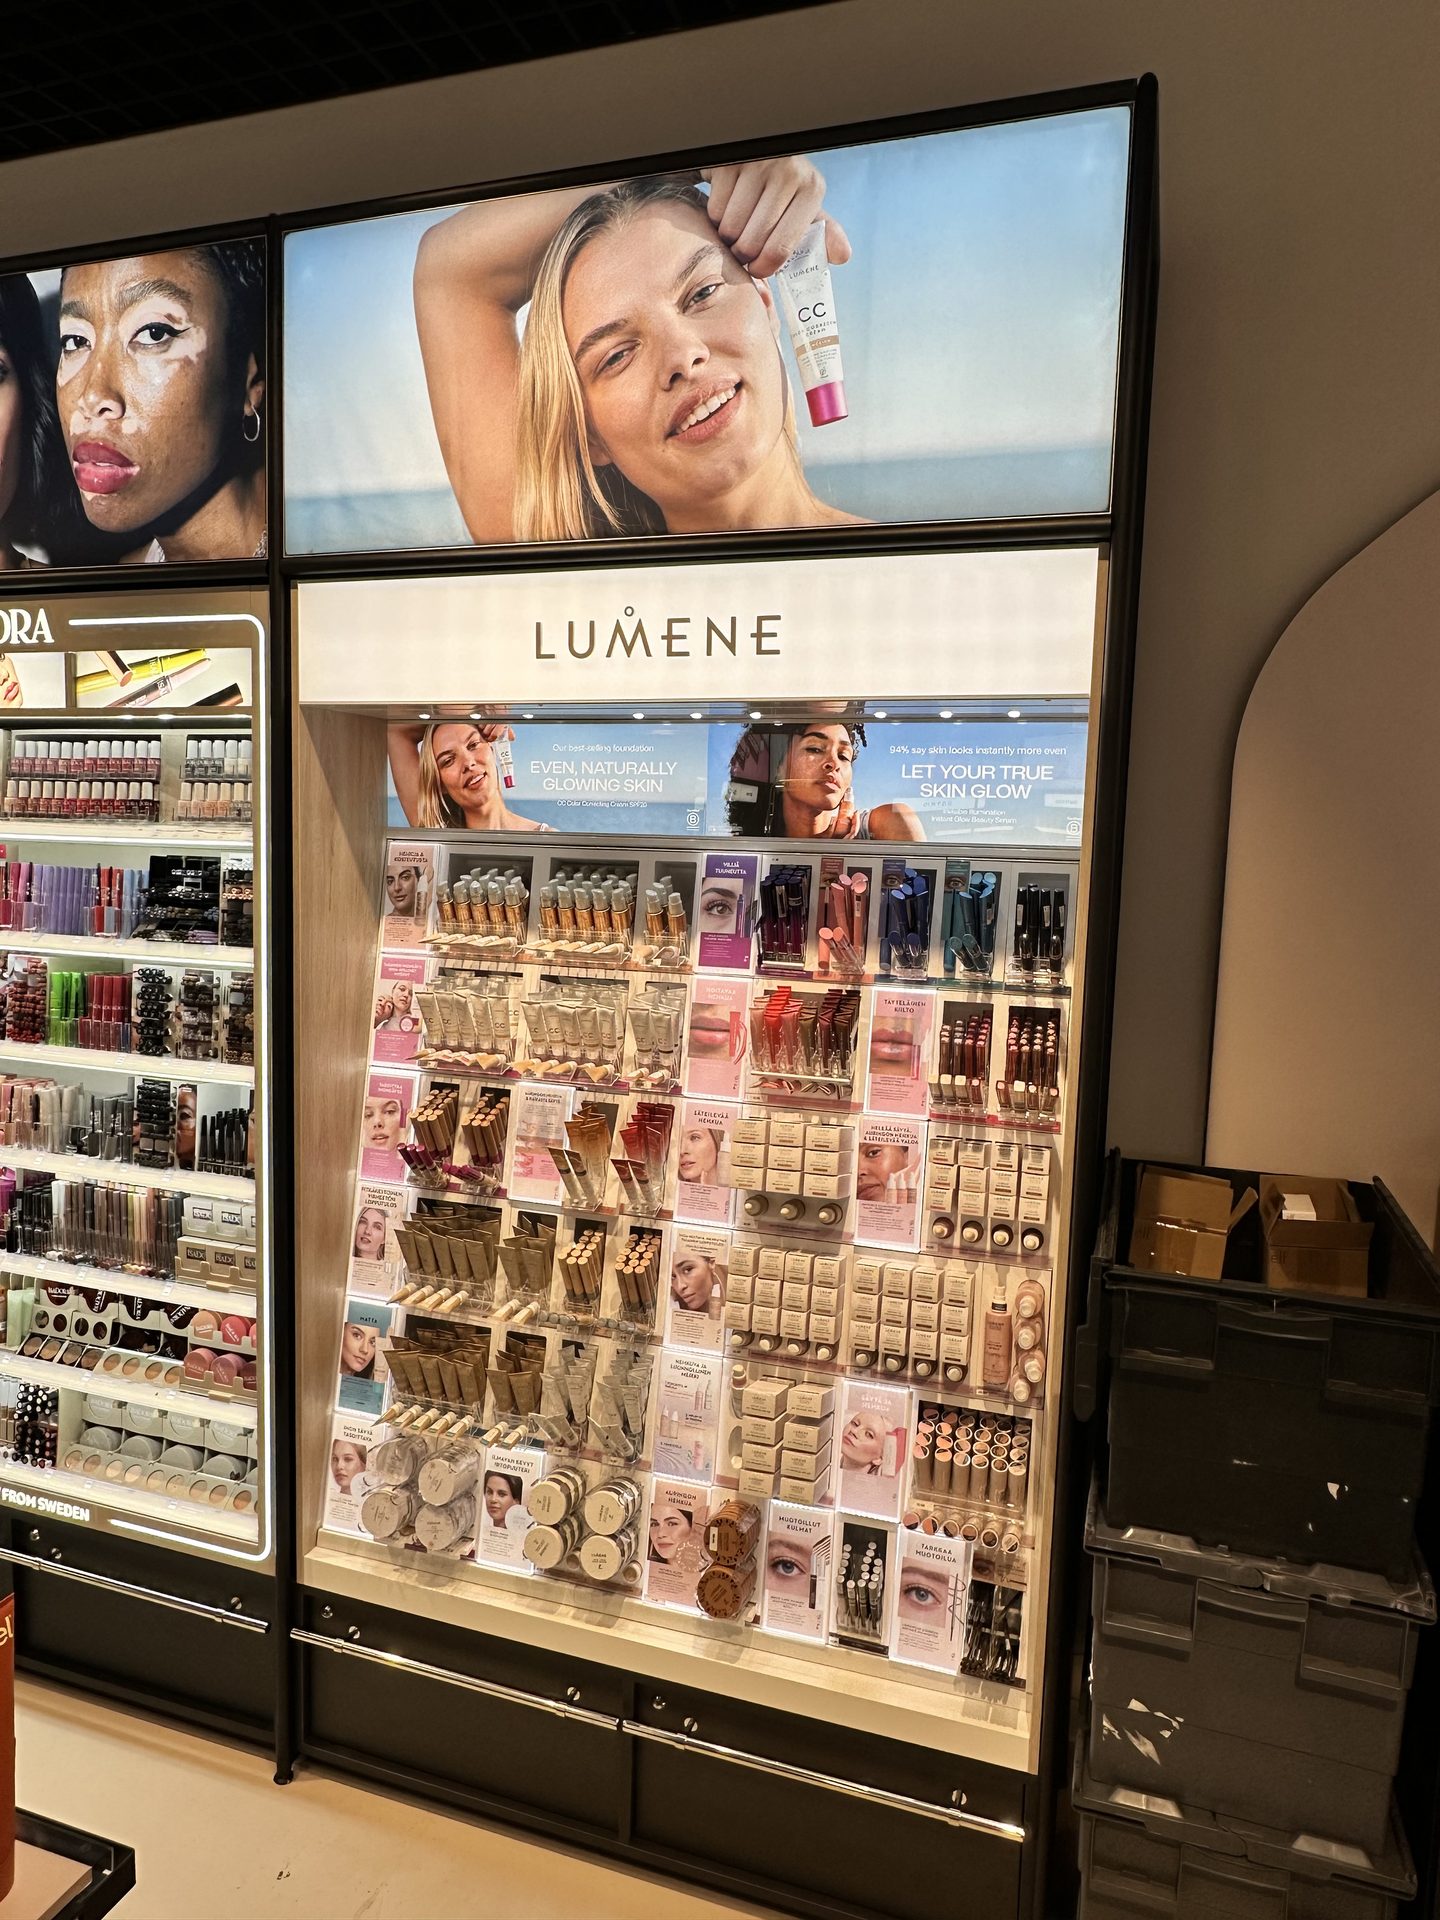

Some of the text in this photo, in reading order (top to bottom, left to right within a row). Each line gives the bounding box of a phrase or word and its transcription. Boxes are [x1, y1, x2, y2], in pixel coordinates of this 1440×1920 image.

[798, 302, 827, 323] CC
[535, 606, 782, 659] LUMENE
[552, 744, 654, 754] Our best-selling foundation
[889, 745, 909, 754] 94%
[911, 747, 926, 755] say
[928, 745, 947, 754] skin
[948, 746, 974, 755] looks
[975, 746, 1017, 756] instantly
[1043, 748, 1067, 756] even
[530, 761, 678, 776] EVEN, NATURALLY
[901, 764, 1055, 781] LET YOUR TRUE
[543, 778, 663, 793] GLOWING SKIN
[920, 783, 1032, 799] SKIN GLOW
[931, 815, 954, 823] Instant
[1, 1487, 90, 1522] FROM SWEDEN
[778, 1515, 821, 1528] MUOTOILLUT
[786, 1524, 813, 1534] KULMAT
[915, 1549, 957, 1563] MUOTOILUA
[921, 1543, 953, 1555] TARKKAA
